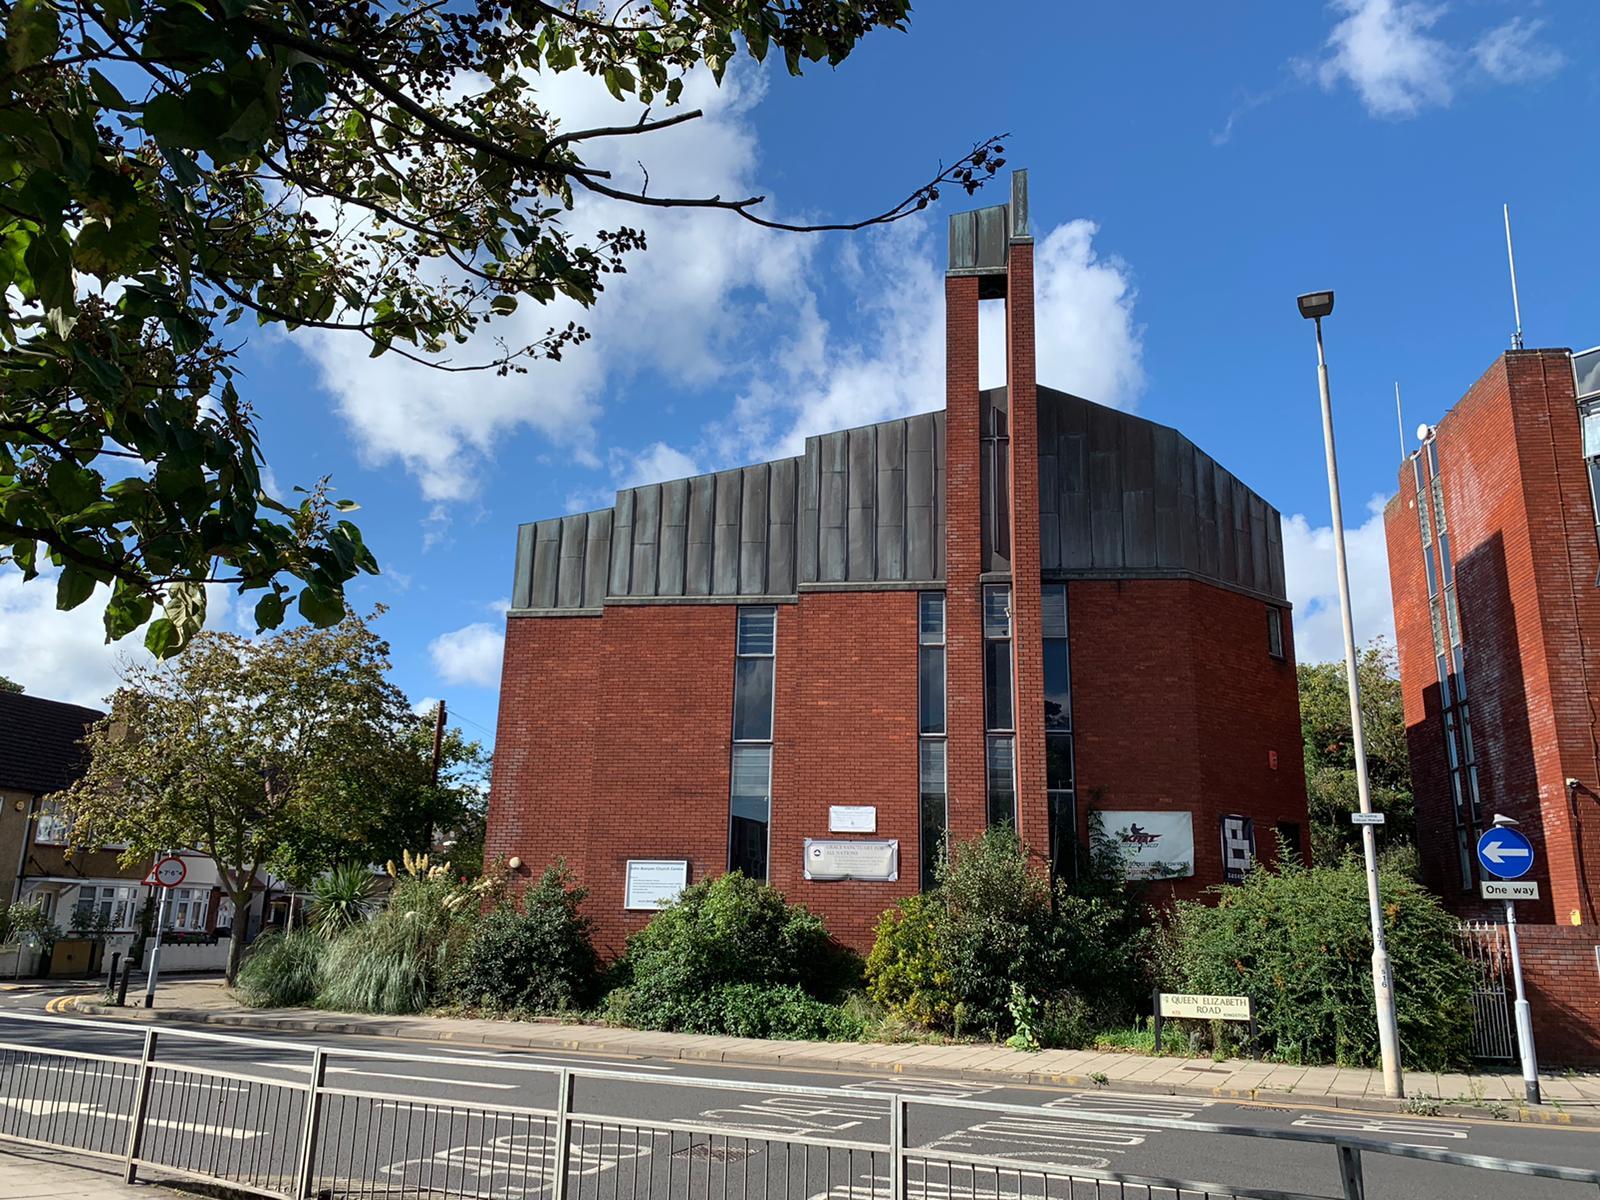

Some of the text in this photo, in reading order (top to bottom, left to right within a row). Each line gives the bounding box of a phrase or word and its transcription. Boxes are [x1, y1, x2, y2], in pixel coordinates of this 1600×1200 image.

[1486, 885, 1535, 896] One way
[1171, 996, 1198, 1005] QUEEN
[1202, 996, 1247, 1007] ELIZABETH
[1196, 1006, 1222, 1014] ROAD
[379, 1134, 655, 1200] 308
